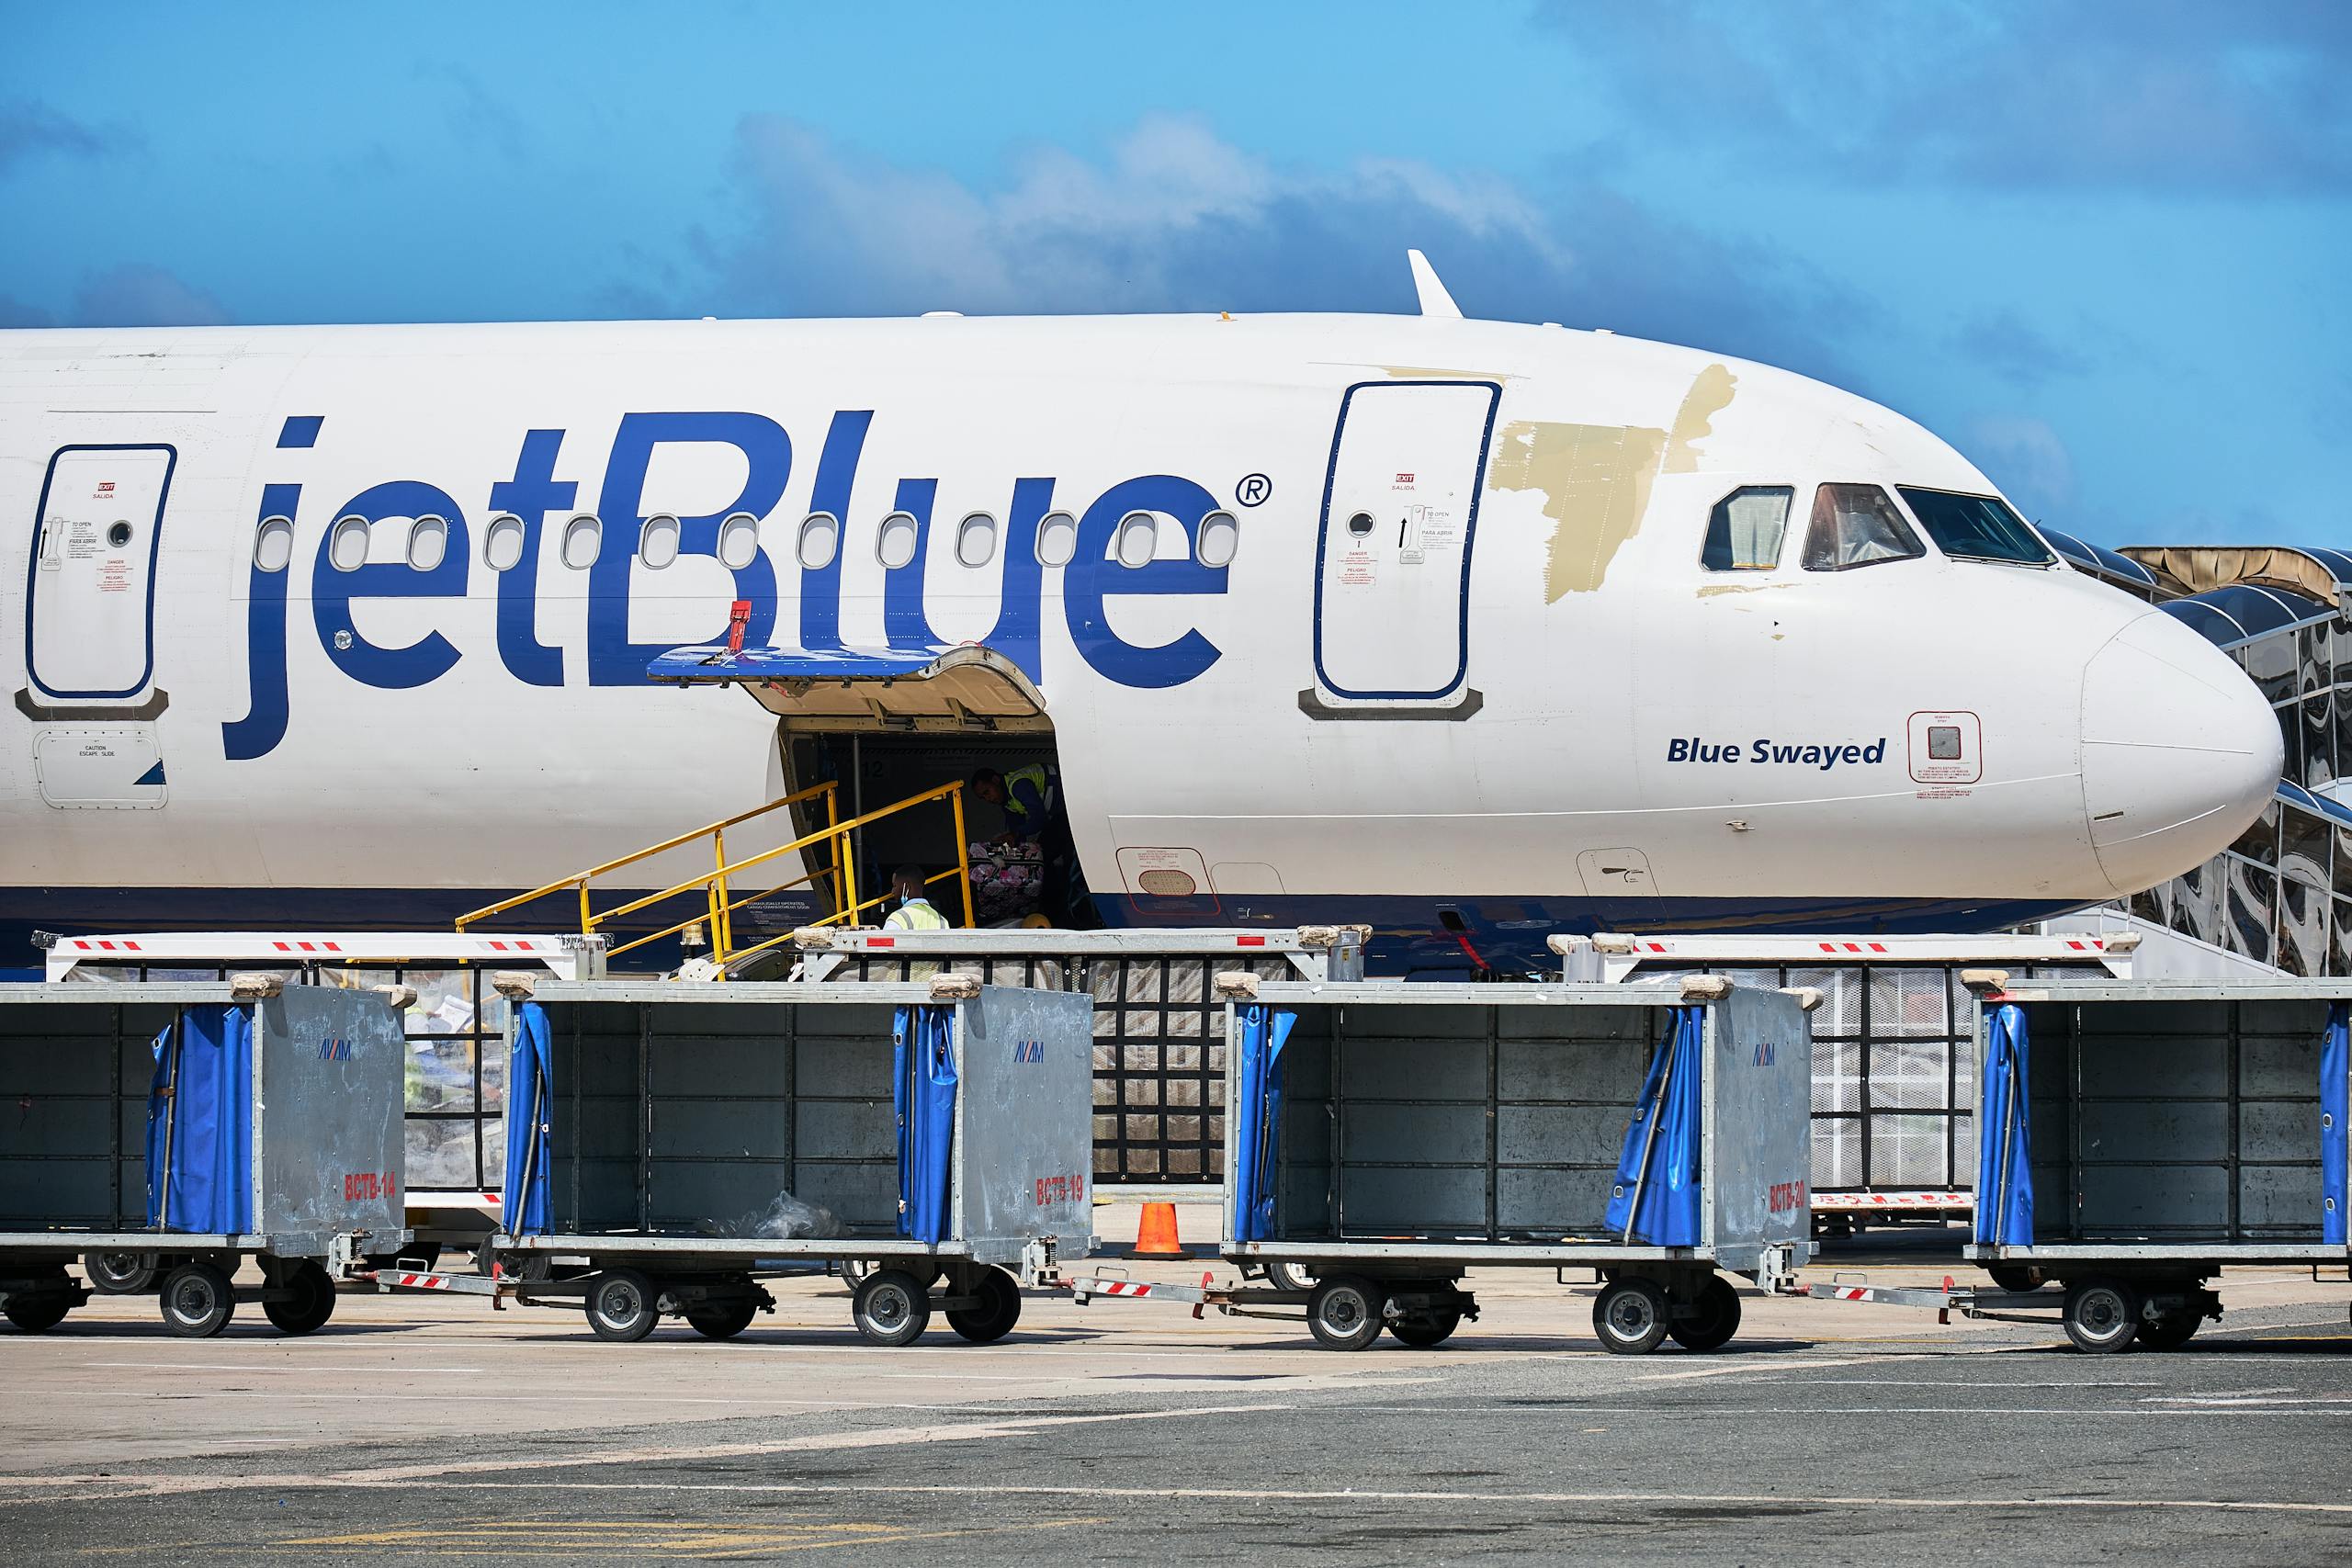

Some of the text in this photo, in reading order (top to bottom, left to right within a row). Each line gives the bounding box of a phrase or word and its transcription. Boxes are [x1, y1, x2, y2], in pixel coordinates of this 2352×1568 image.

[222, 410, 1229, 761] jetBlue
[1667, 737, 1886, 771] Blue Swayed
[345, 1171, 397, 1201] BCTB-14
[1770, 1180, 1804, 1213] BCTB-20
